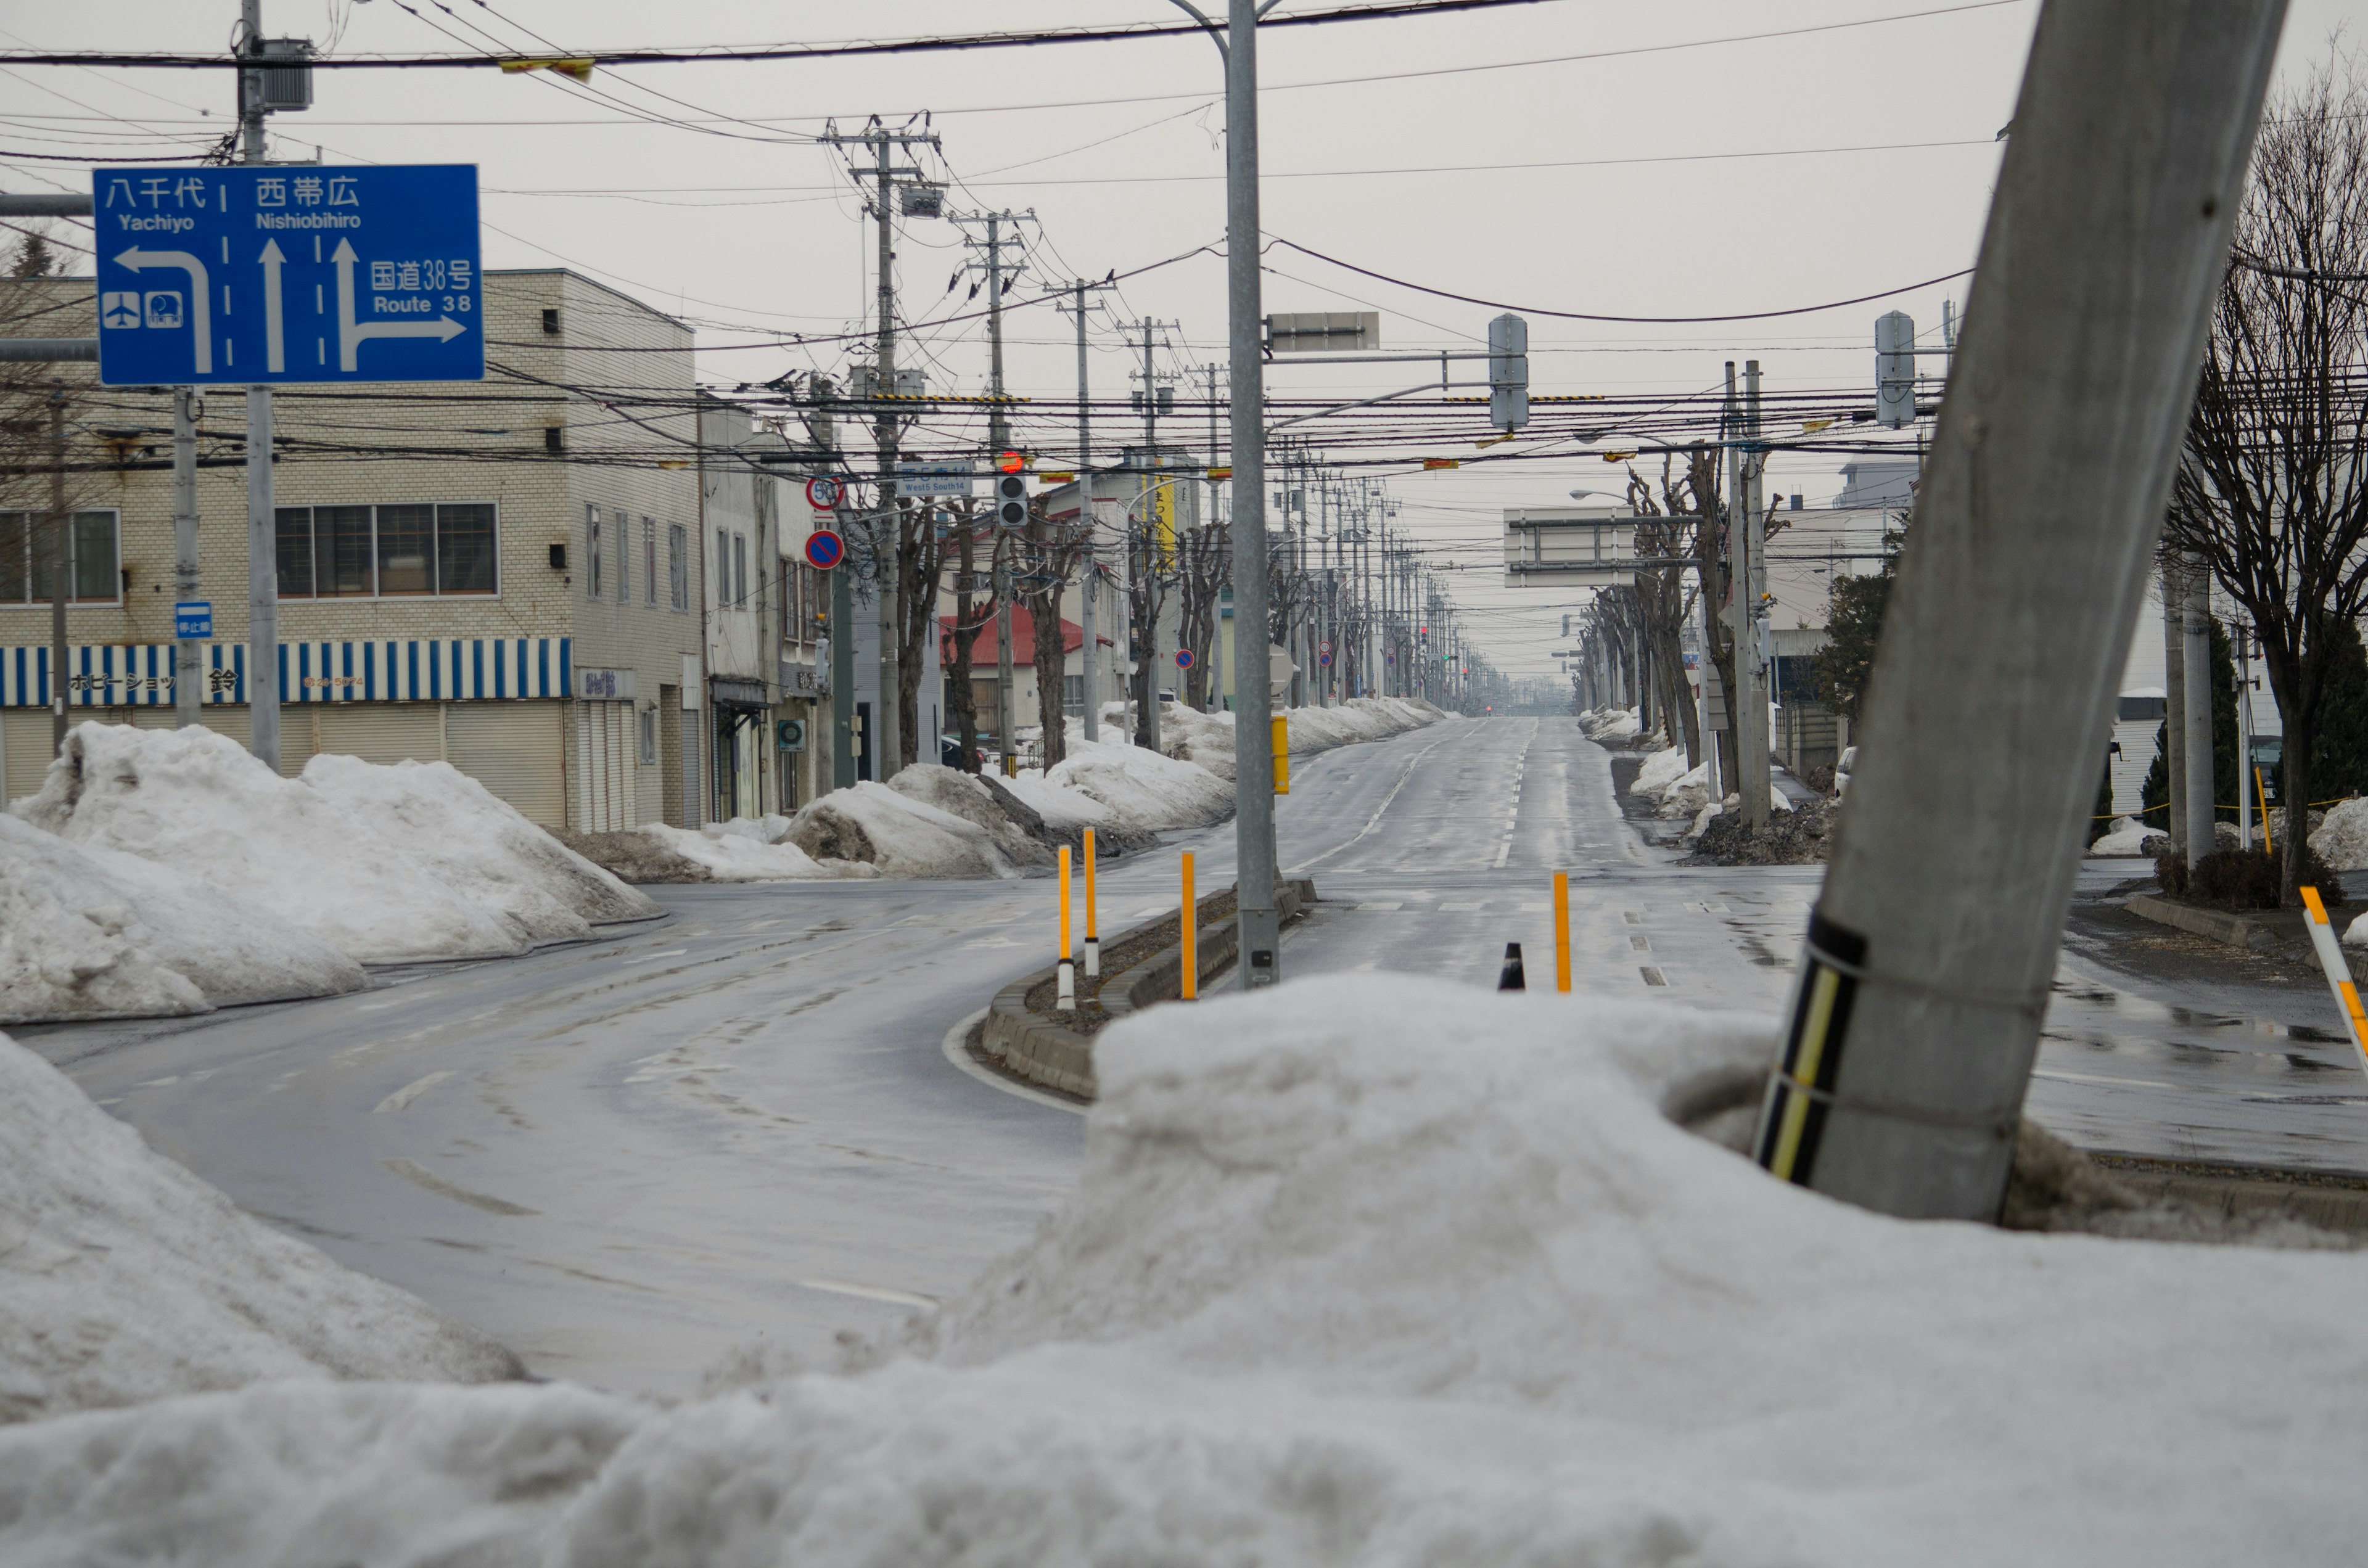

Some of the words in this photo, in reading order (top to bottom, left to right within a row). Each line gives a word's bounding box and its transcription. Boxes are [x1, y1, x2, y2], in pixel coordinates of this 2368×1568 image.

[105, 177, 206, 209] 八千代
[257, 176, 360, 208] 西帯広
[118, 214, 195, 234] Yachiyo
[256, 212, 361, 229] Nishiobihiro
[371, 259, 473, 291] 国道38号
[374, 297, 432, 313] Route
[442, 295, 472, 312] 38
[933, 482, 964, 491] South14
[69, 673, 176, 691] ホビーショッ
[208, 668, 239, 694] 鈴
